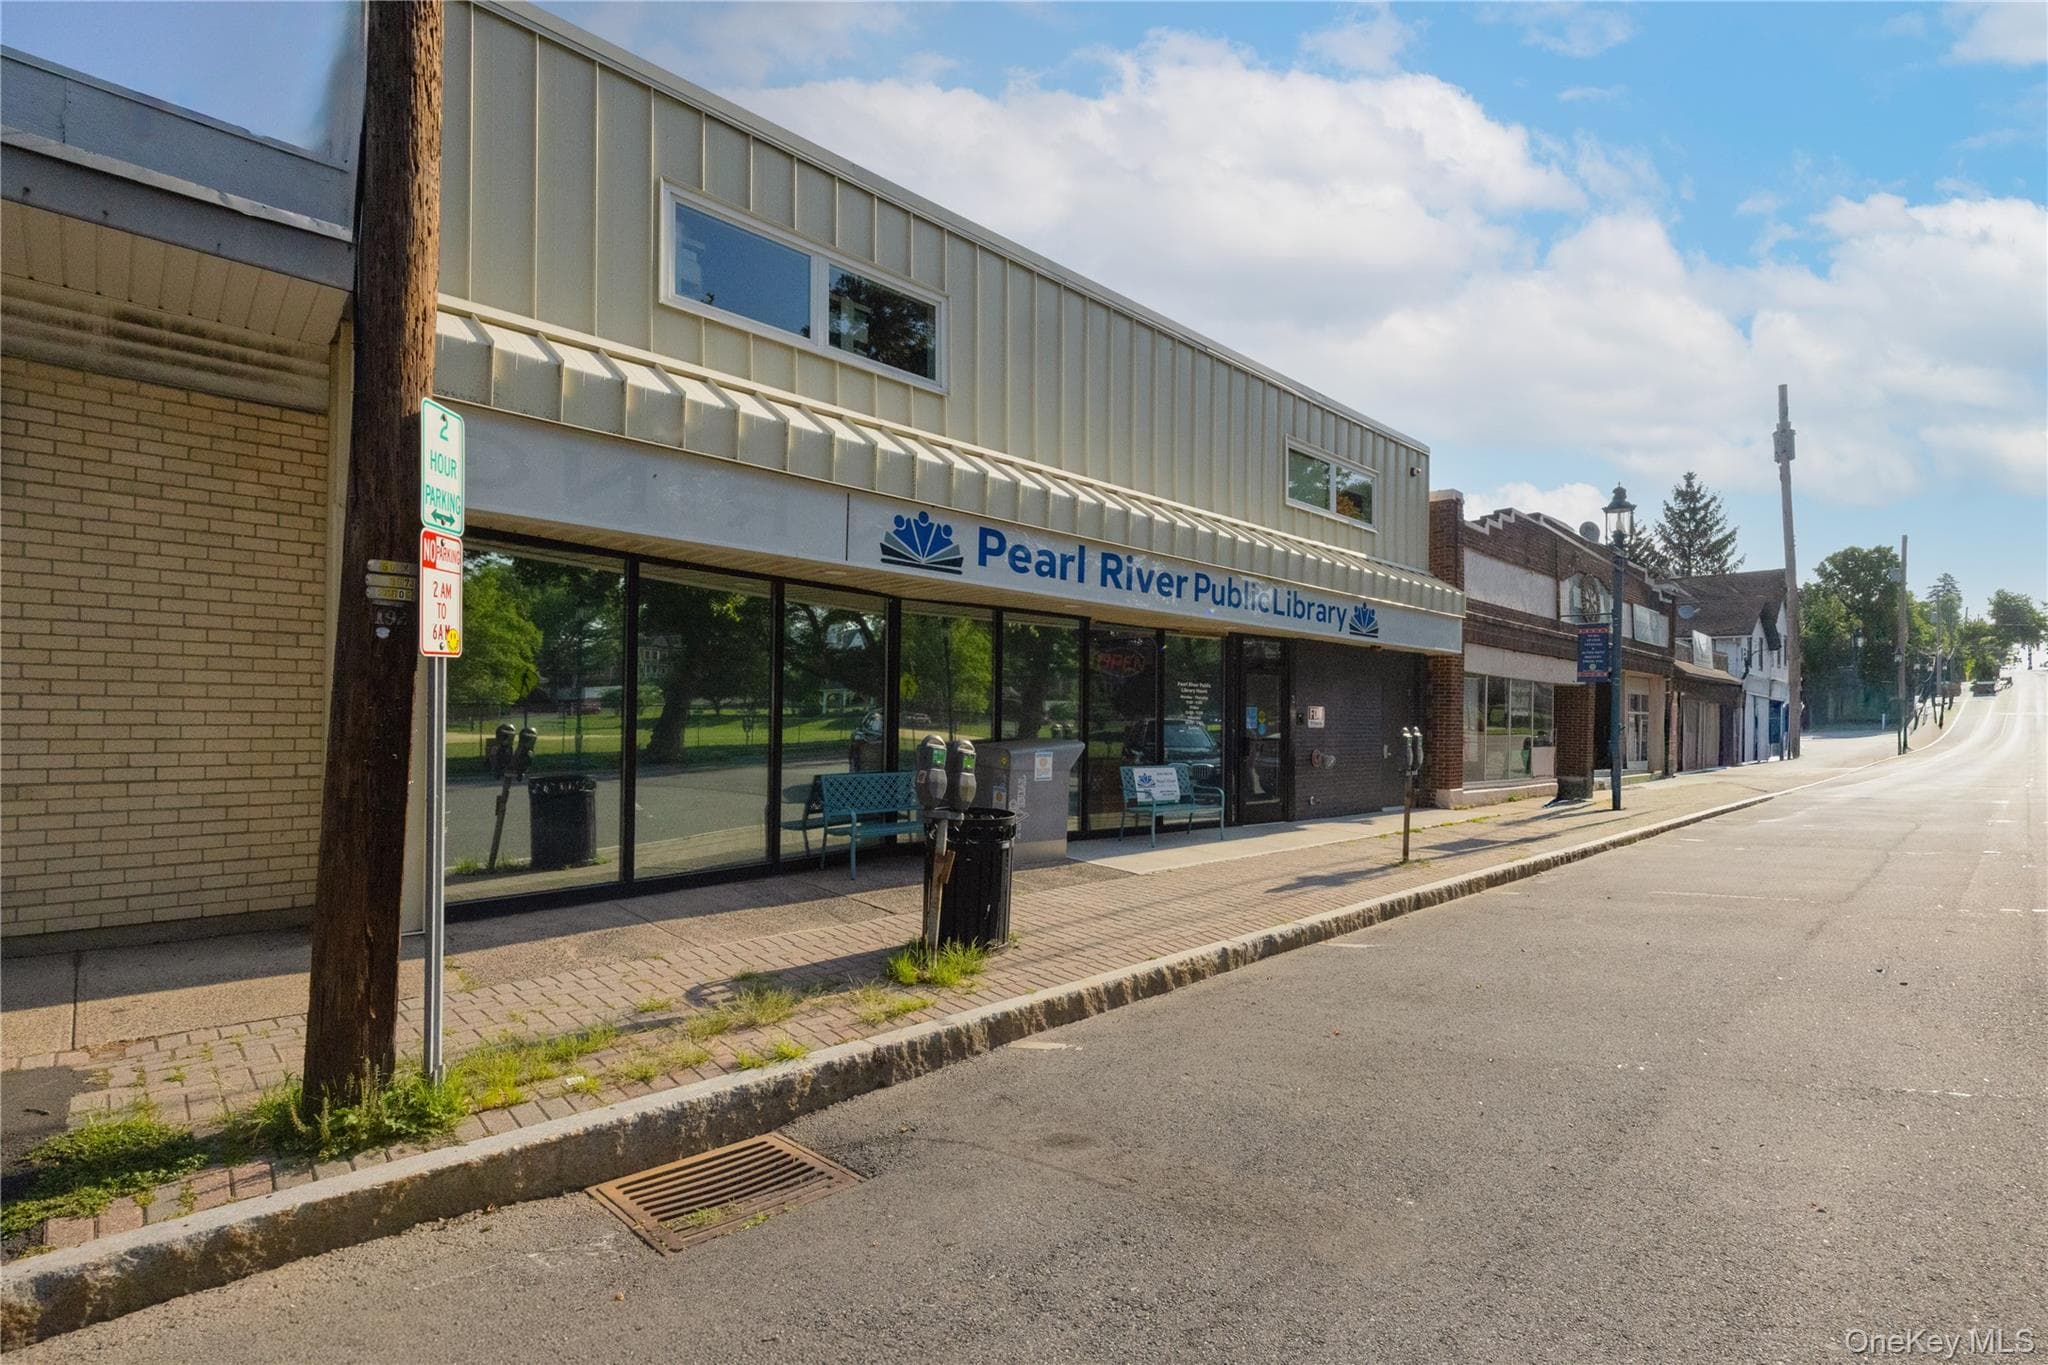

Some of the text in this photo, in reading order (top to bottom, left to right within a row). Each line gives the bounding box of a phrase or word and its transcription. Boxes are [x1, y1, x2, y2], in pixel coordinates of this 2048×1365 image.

[439, 416, 449, 441] 2
[430, 449, 457, 479] HOUR
[425, 484, 461, 515] PARKING
[423, 538, 460, 566] NO PARKING
[433, 581, 439, 598] 2
[440, 582, 452, 600] AM
[977, 526, 1348, 632] Pearl River Public Library
[437, 602, 447, 620] TO
